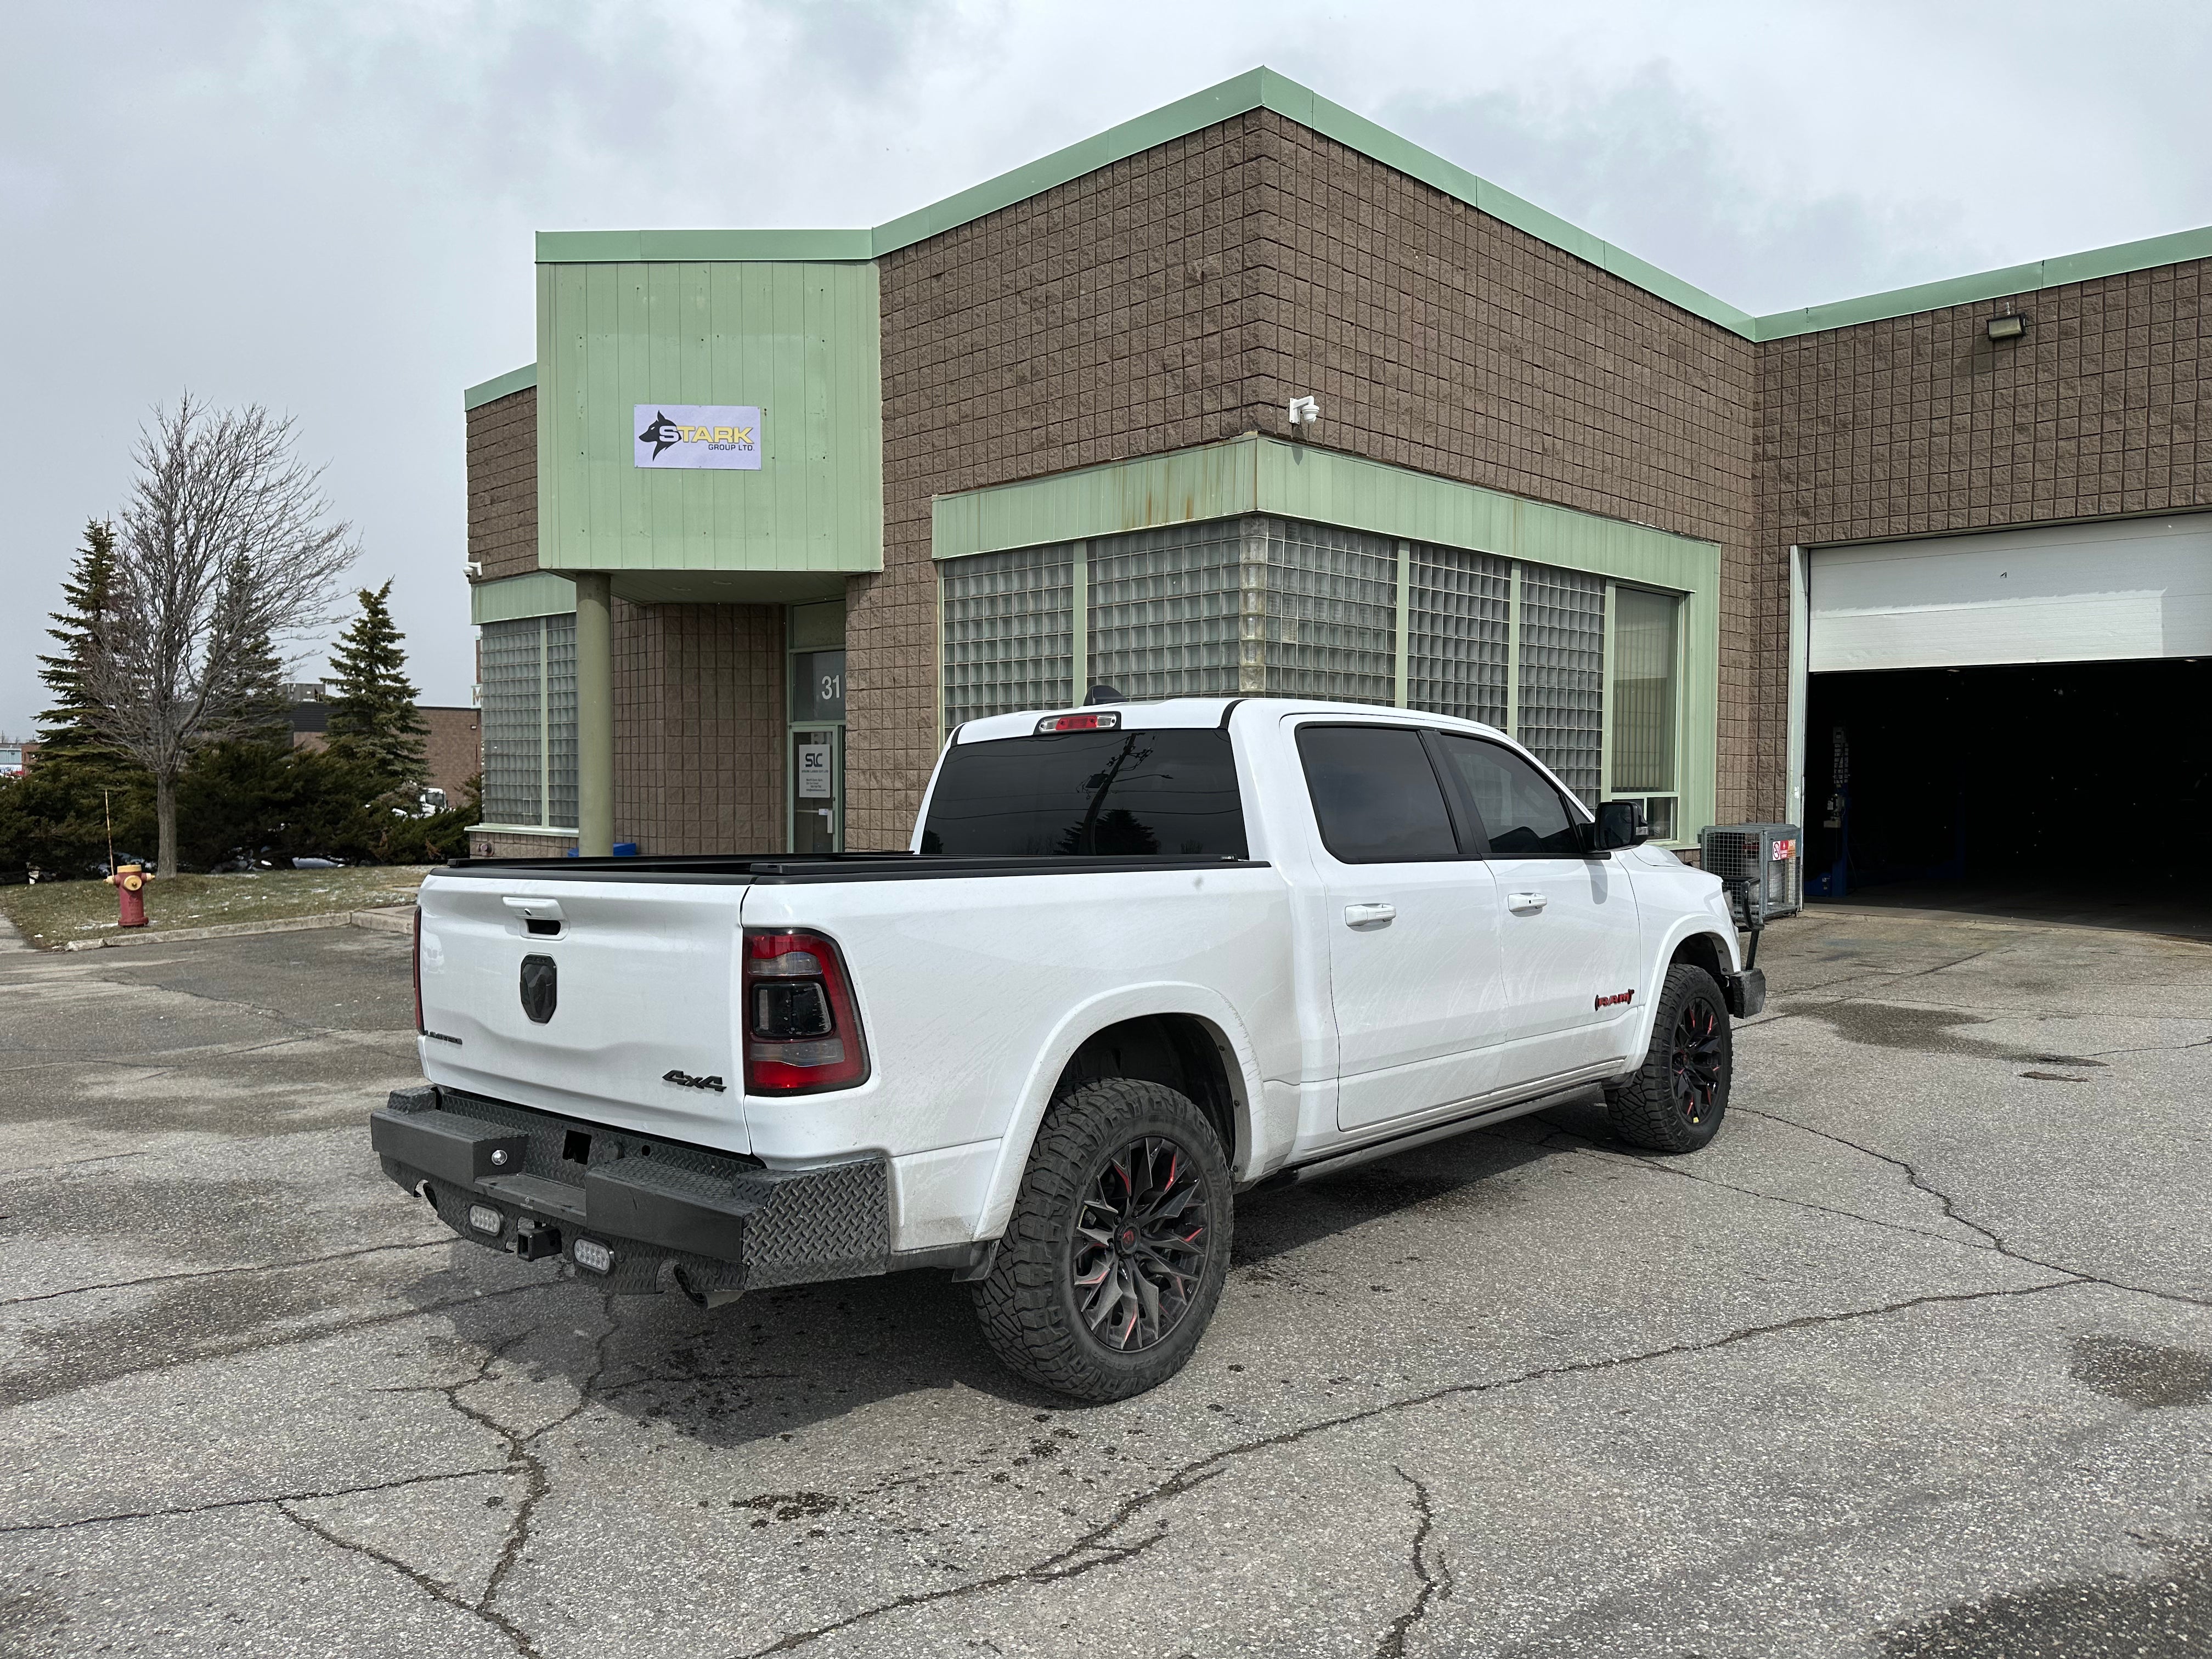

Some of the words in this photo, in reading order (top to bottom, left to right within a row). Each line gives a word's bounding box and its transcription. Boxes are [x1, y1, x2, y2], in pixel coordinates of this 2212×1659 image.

[659, 425, 755, 444] STARK
[821, 675, 840, 700] 31
[805, 753, 823, 768] SLC
